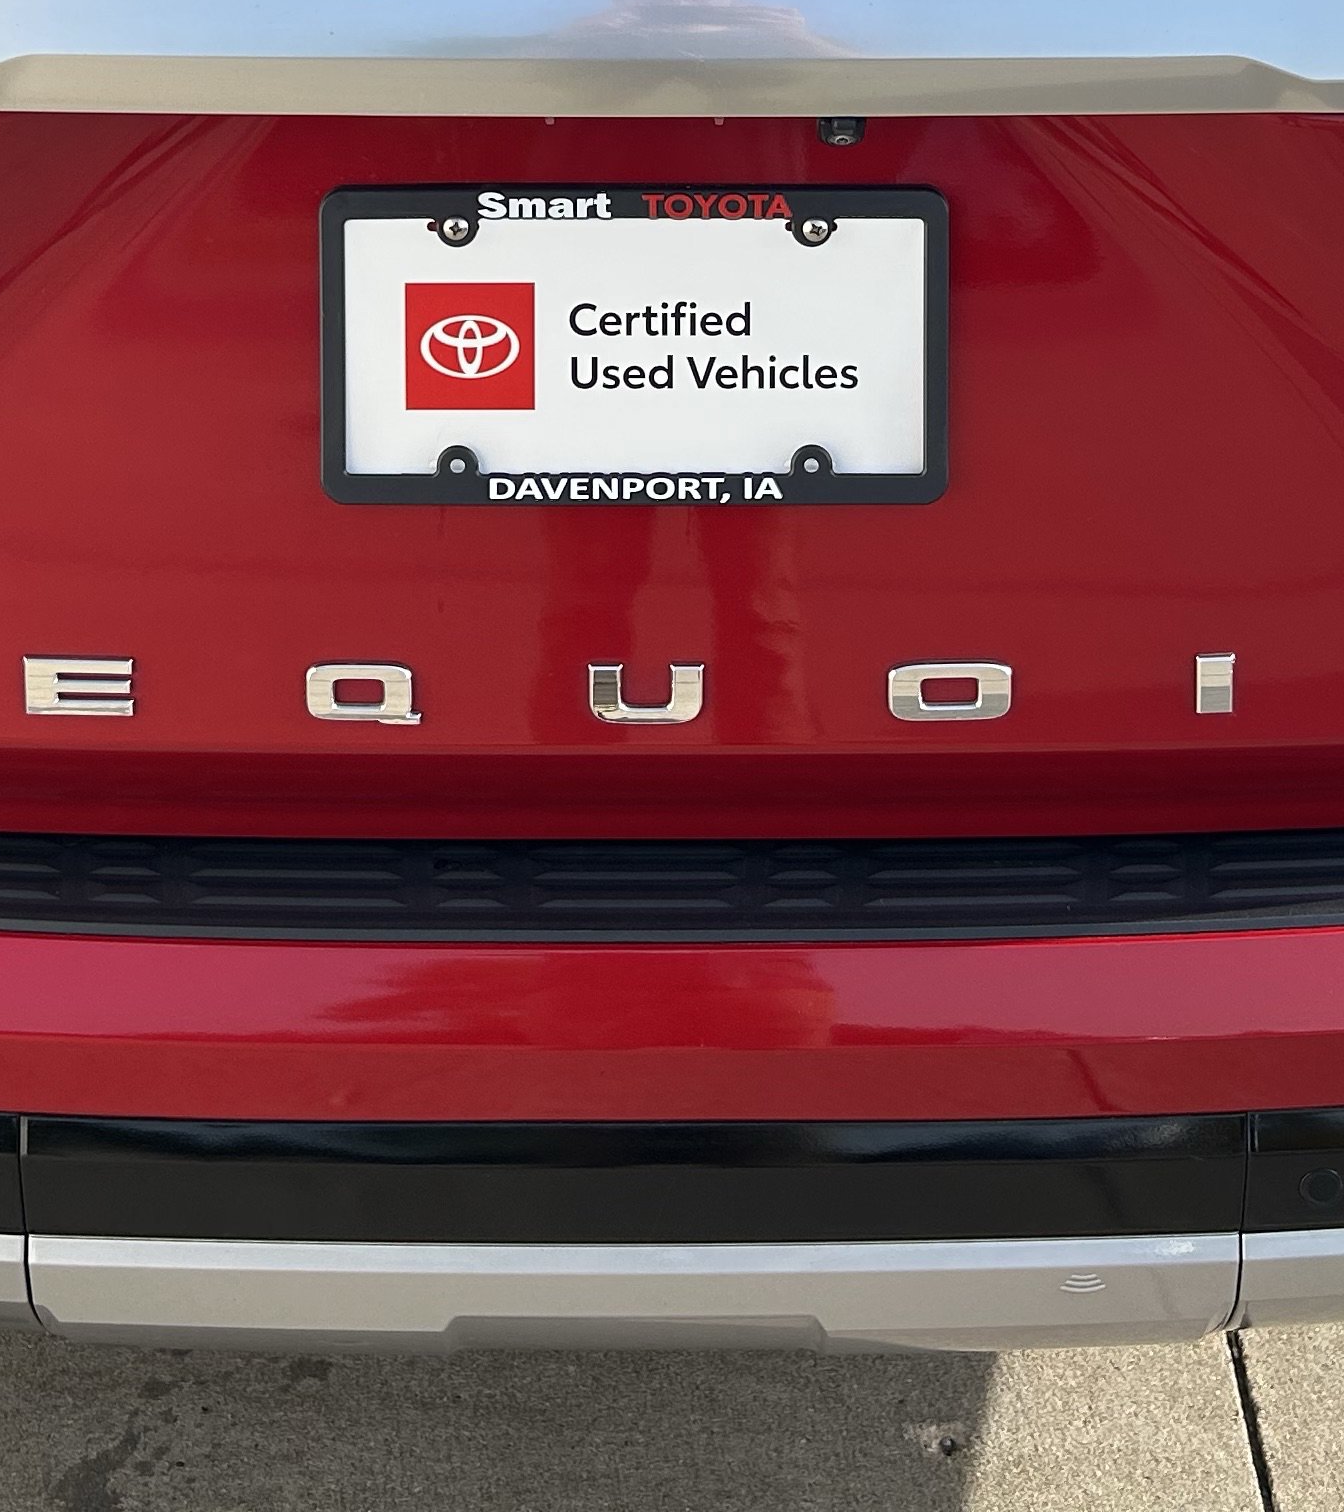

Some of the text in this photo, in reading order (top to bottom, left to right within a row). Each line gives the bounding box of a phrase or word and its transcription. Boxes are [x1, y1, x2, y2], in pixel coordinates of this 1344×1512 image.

[477, 191, 793, 220] Smart TOYOTA
[569, 301, 751, 336] Certified
[570, 354, 859, 389] Used Vehicles
[488, 476, 784, 504] DAVENPORT, IA
